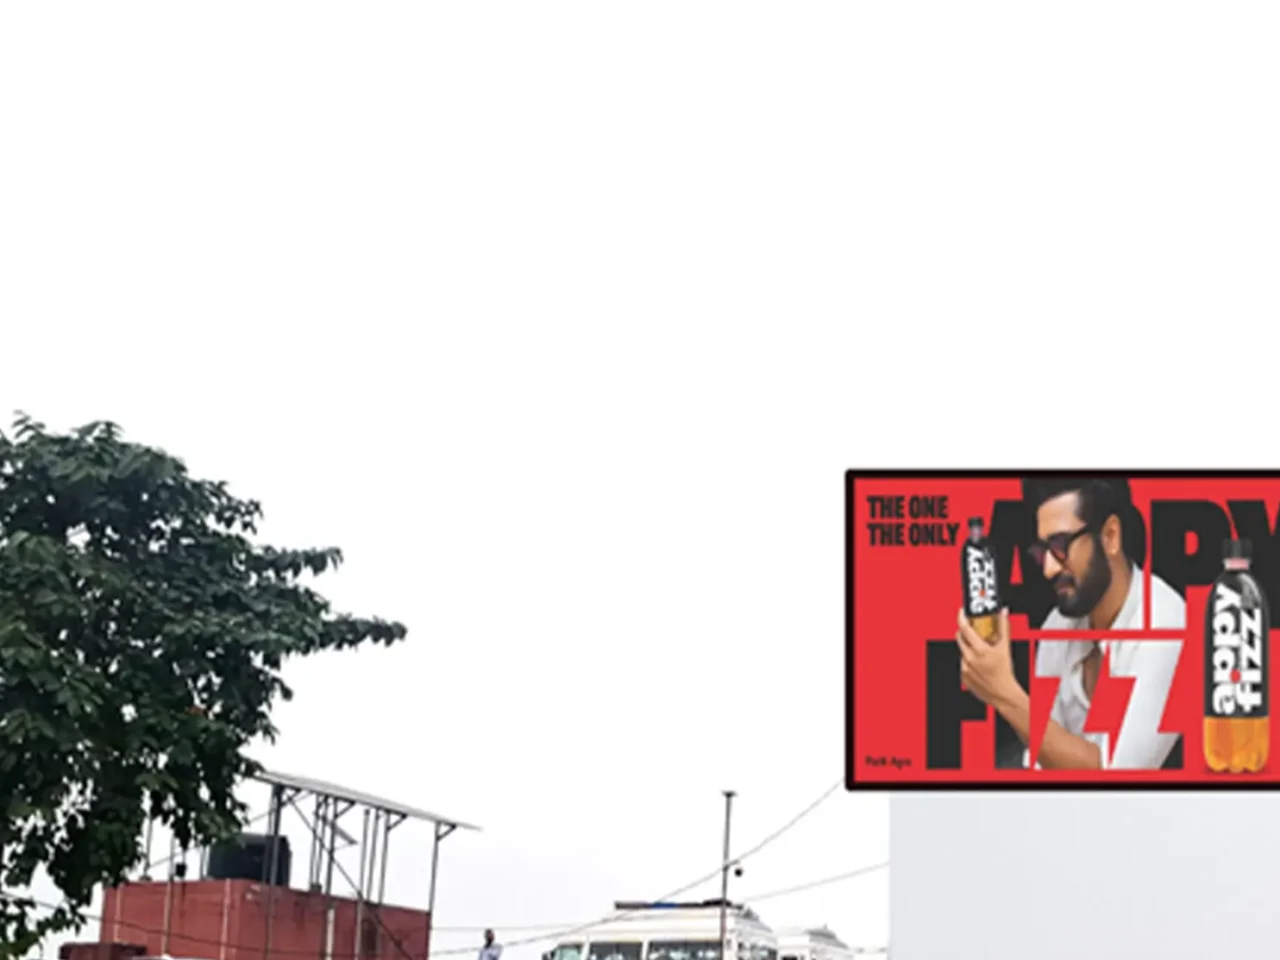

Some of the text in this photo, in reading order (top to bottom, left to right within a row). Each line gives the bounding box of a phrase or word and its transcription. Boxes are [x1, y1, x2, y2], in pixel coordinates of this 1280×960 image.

[866, 495, 949, 519] THE ONE
[866, 522, 960, 547] THE ONLY
